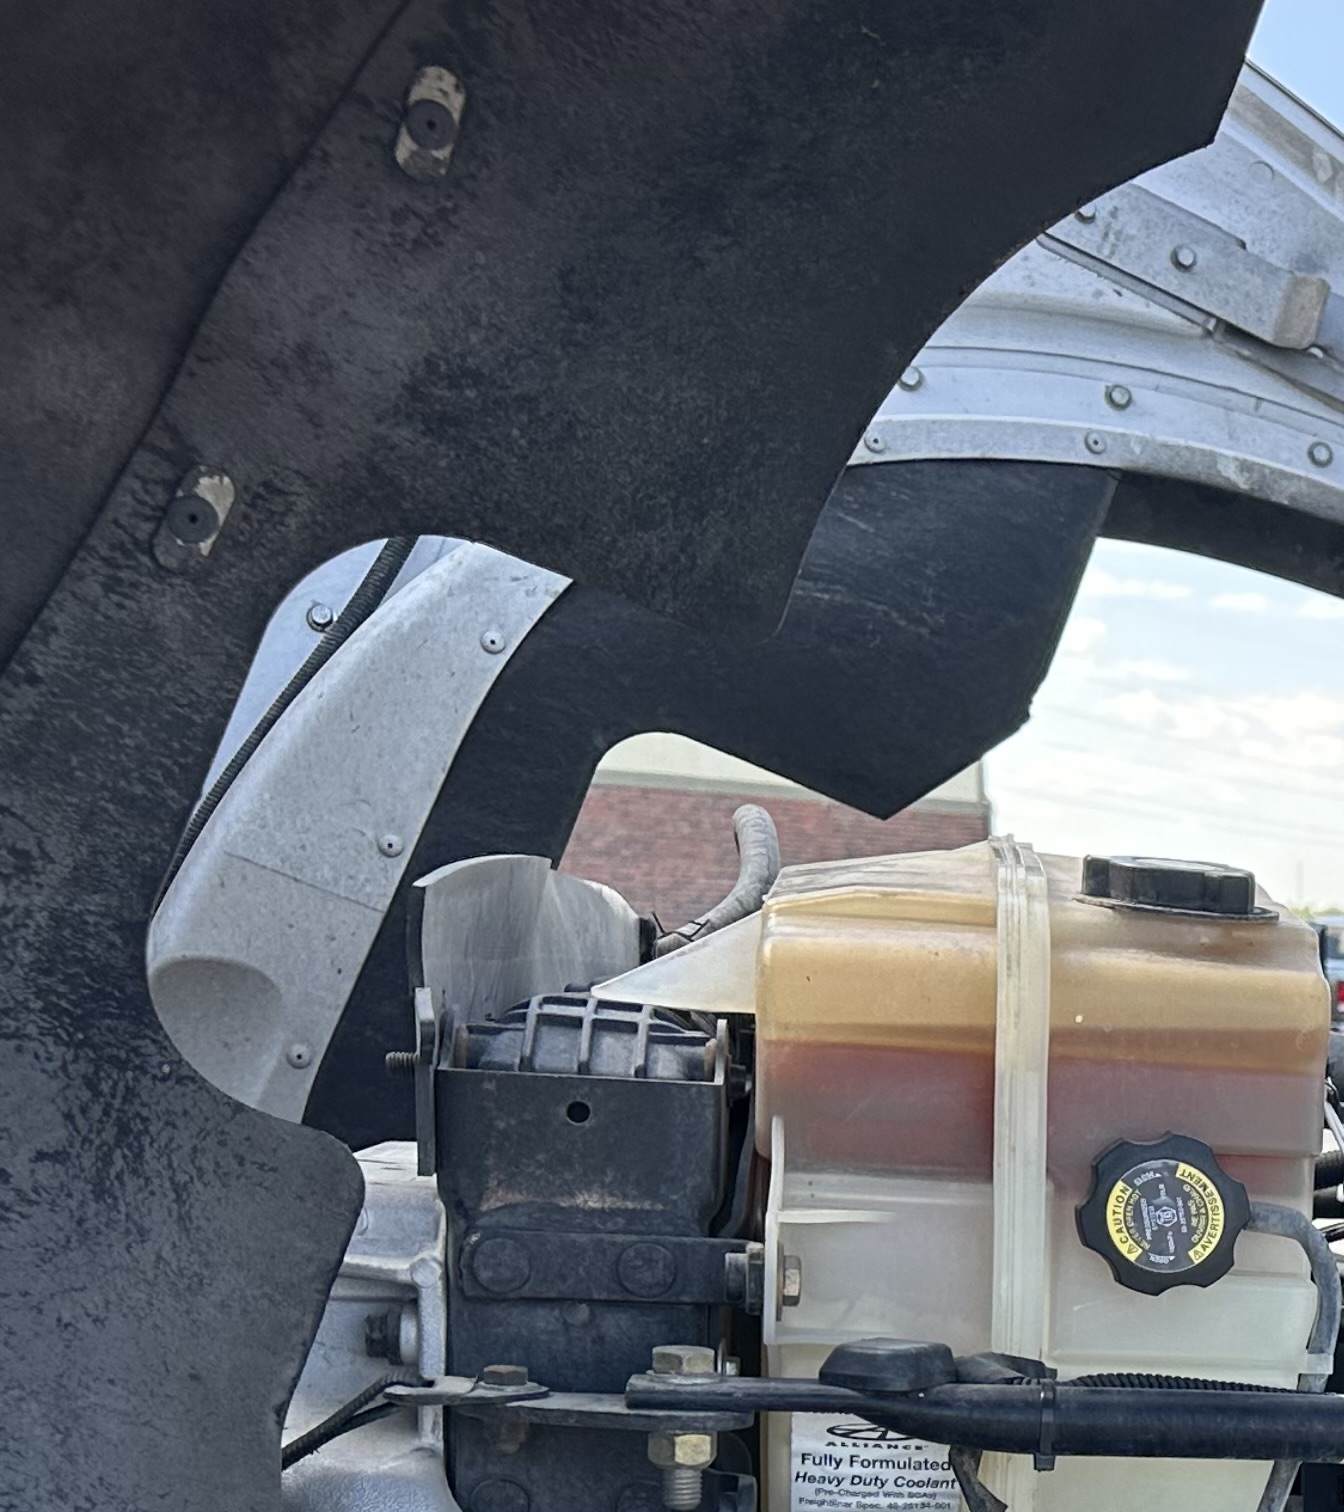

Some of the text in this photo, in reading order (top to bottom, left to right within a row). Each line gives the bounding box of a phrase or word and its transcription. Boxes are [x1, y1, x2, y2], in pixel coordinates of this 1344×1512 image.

[1111, 1186, 1131, 1245] CAUTION
[1179, 1167, 1221, 1252] AVERTISSEMENT
[825, 1441, 924, 1451] ALLIANCE
[801, 1452, 951, 1471] Fully Formulated
[794, 1471, 958, 1490] Heavy Duty Coolant
